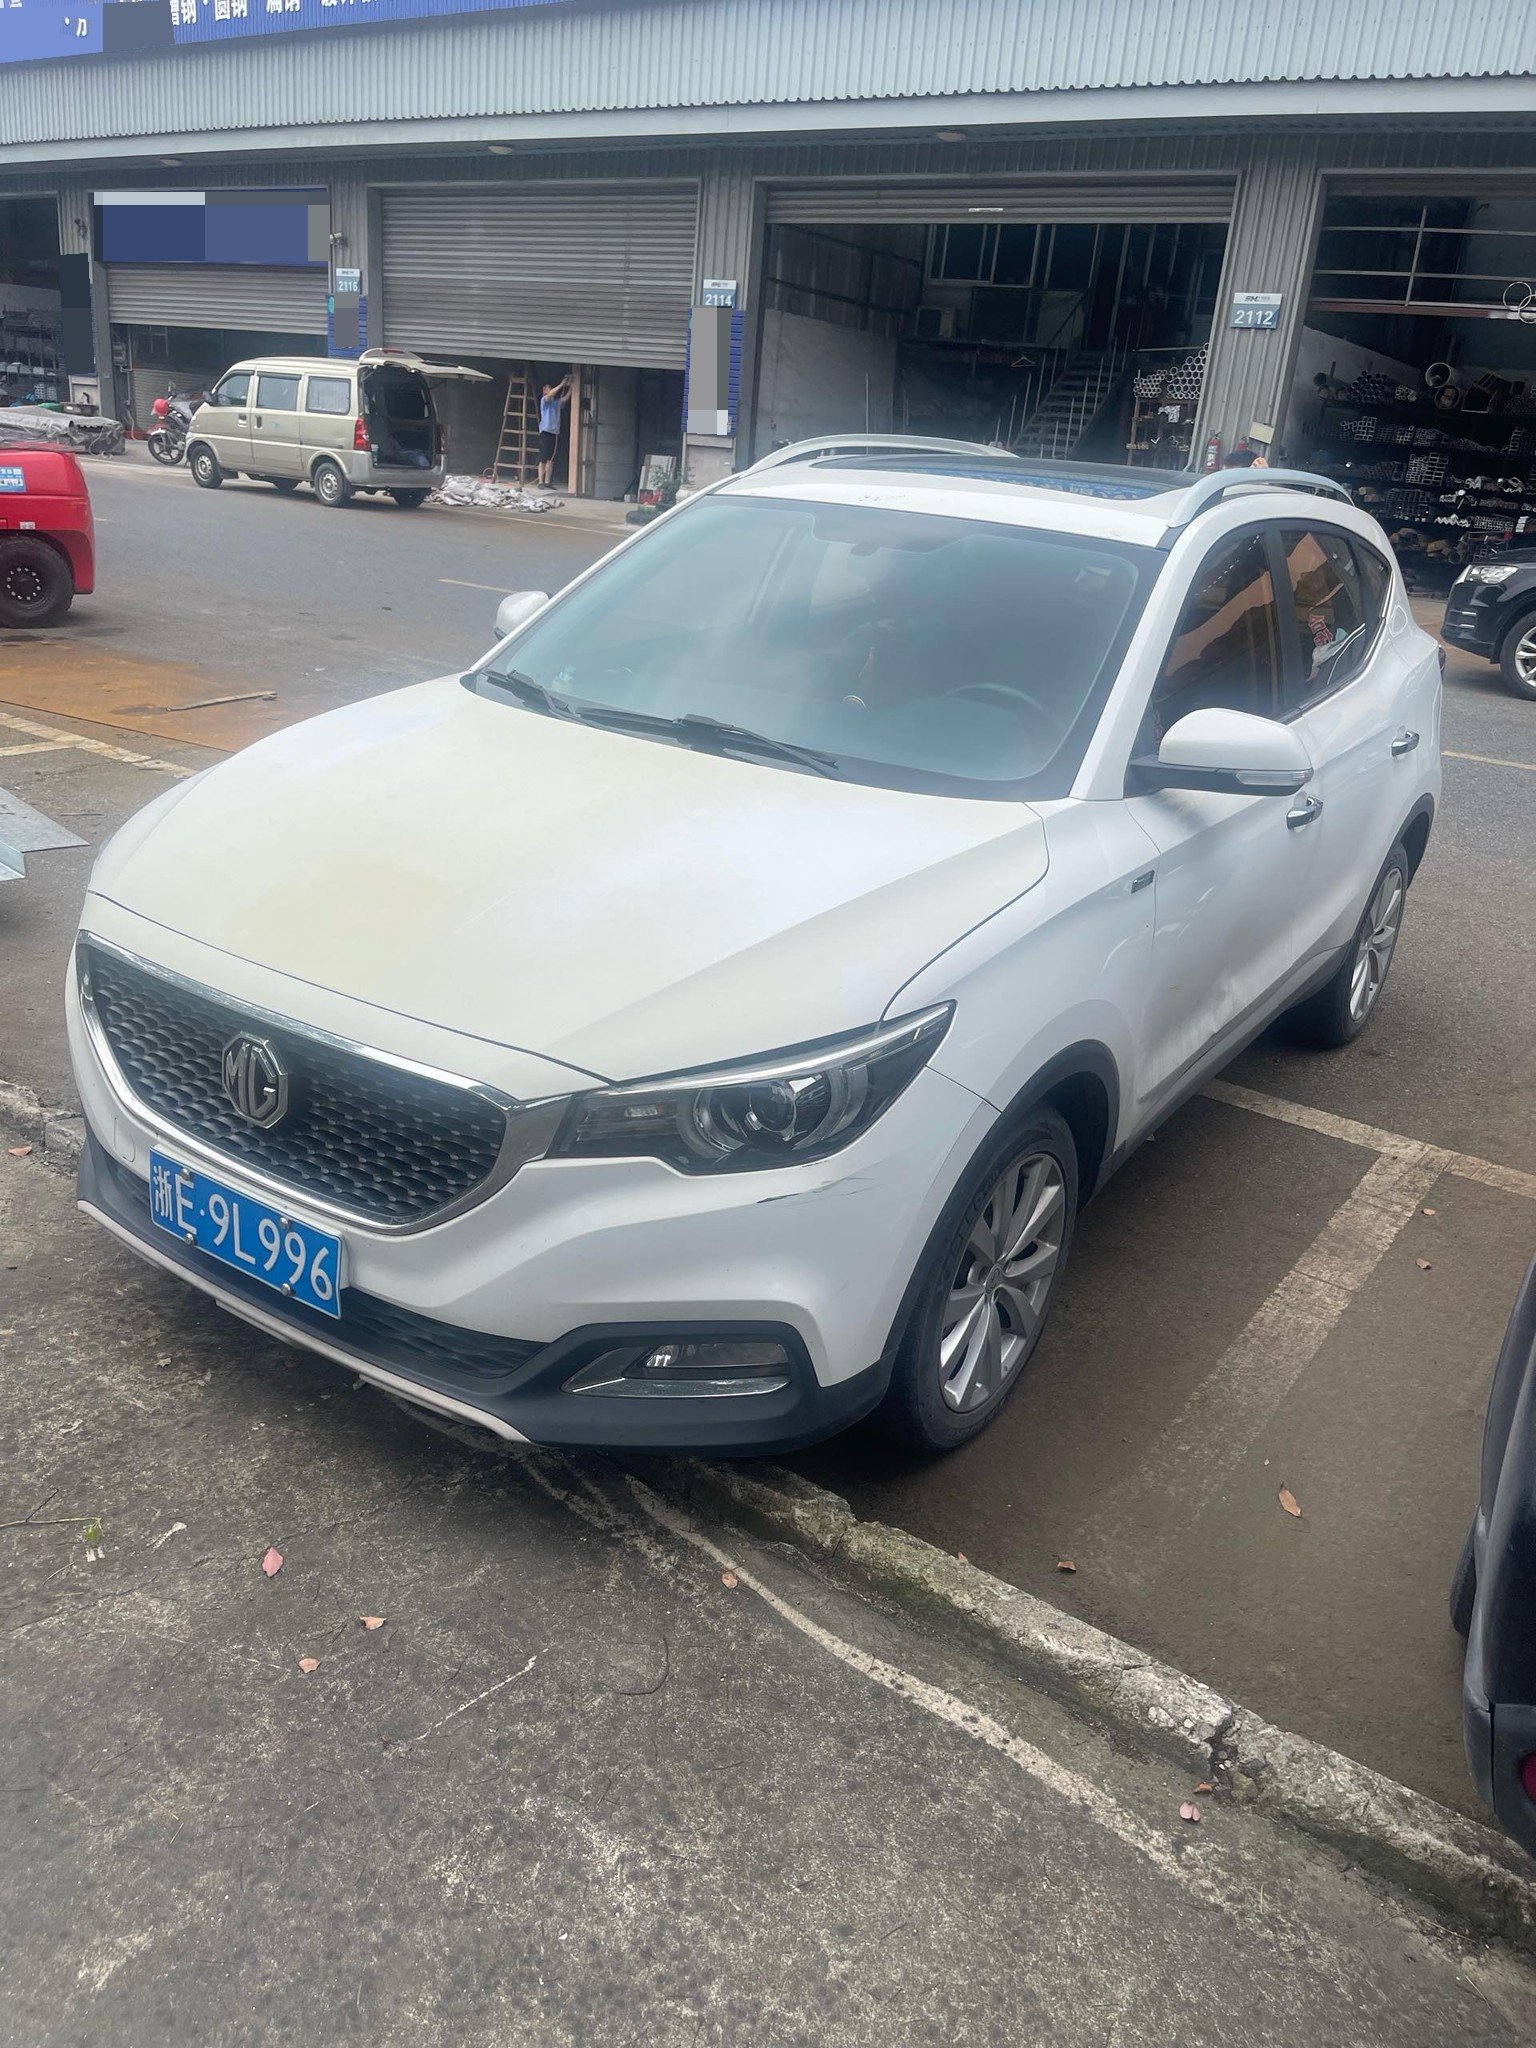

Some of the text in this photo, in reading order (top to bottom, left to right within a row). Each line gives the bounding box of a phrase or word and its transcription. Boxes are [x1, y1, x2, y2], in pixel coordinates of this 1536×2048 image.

[338, 280, 358, 292] 2116
[705, 293, 733, 306] 2114
[1234, 309, 1274, 325] 2112
[224, 1040, 279, 1120] MG
